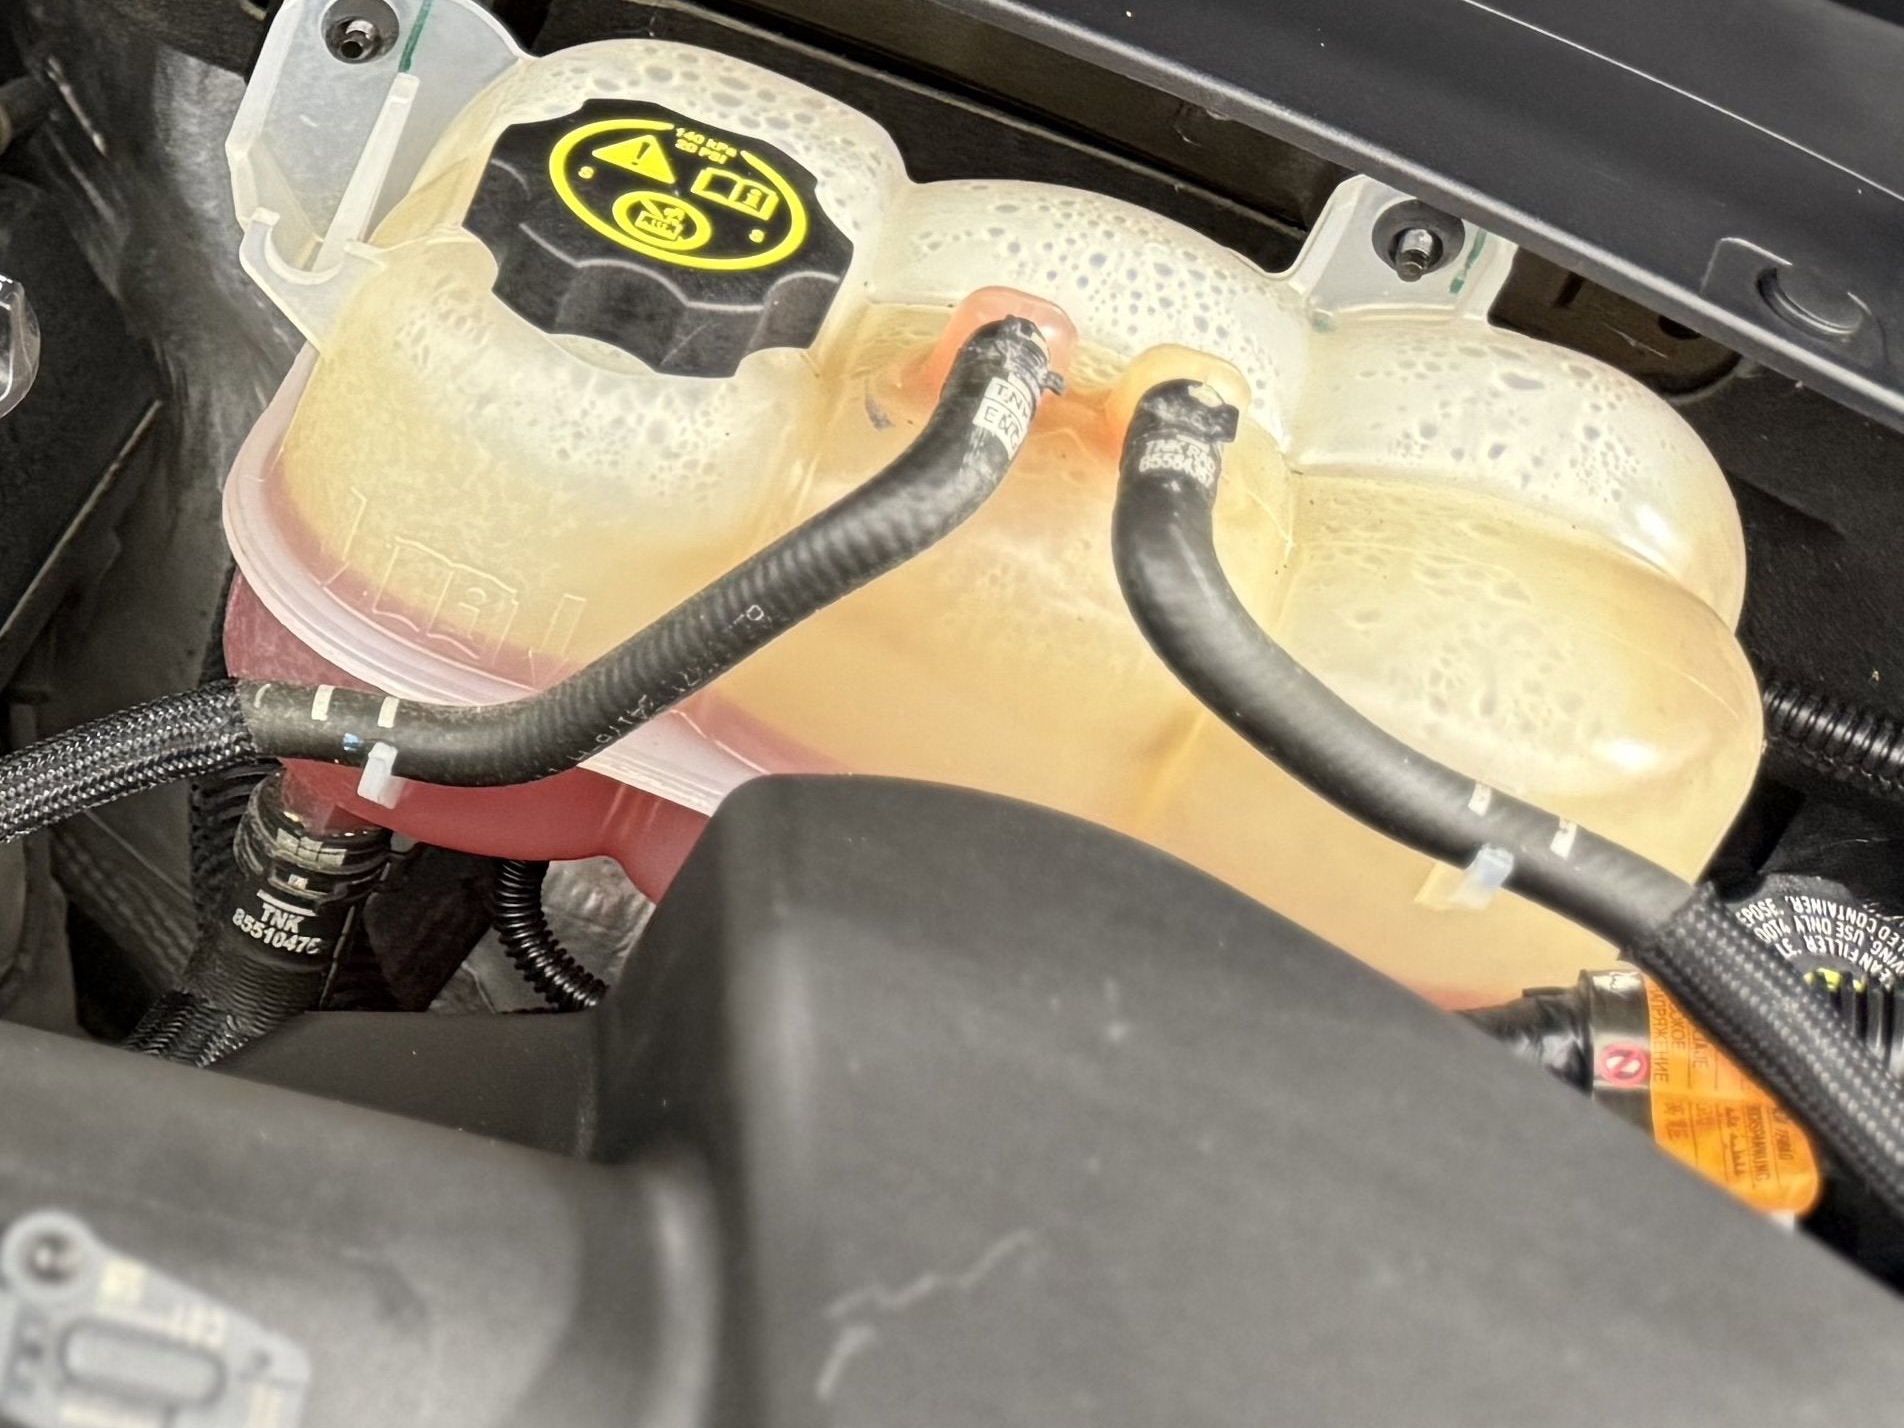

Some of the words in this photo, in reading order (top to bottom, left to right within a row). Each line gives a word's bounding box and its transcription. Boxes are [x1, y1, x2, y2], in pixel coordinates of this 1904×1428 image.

[260, 902, 305, 934] TNK
[1792, 914, 1833, 936] ONLY
[1835, 920, 1865, 947] USE
[1803, 933, 1860, 963] FILLER
